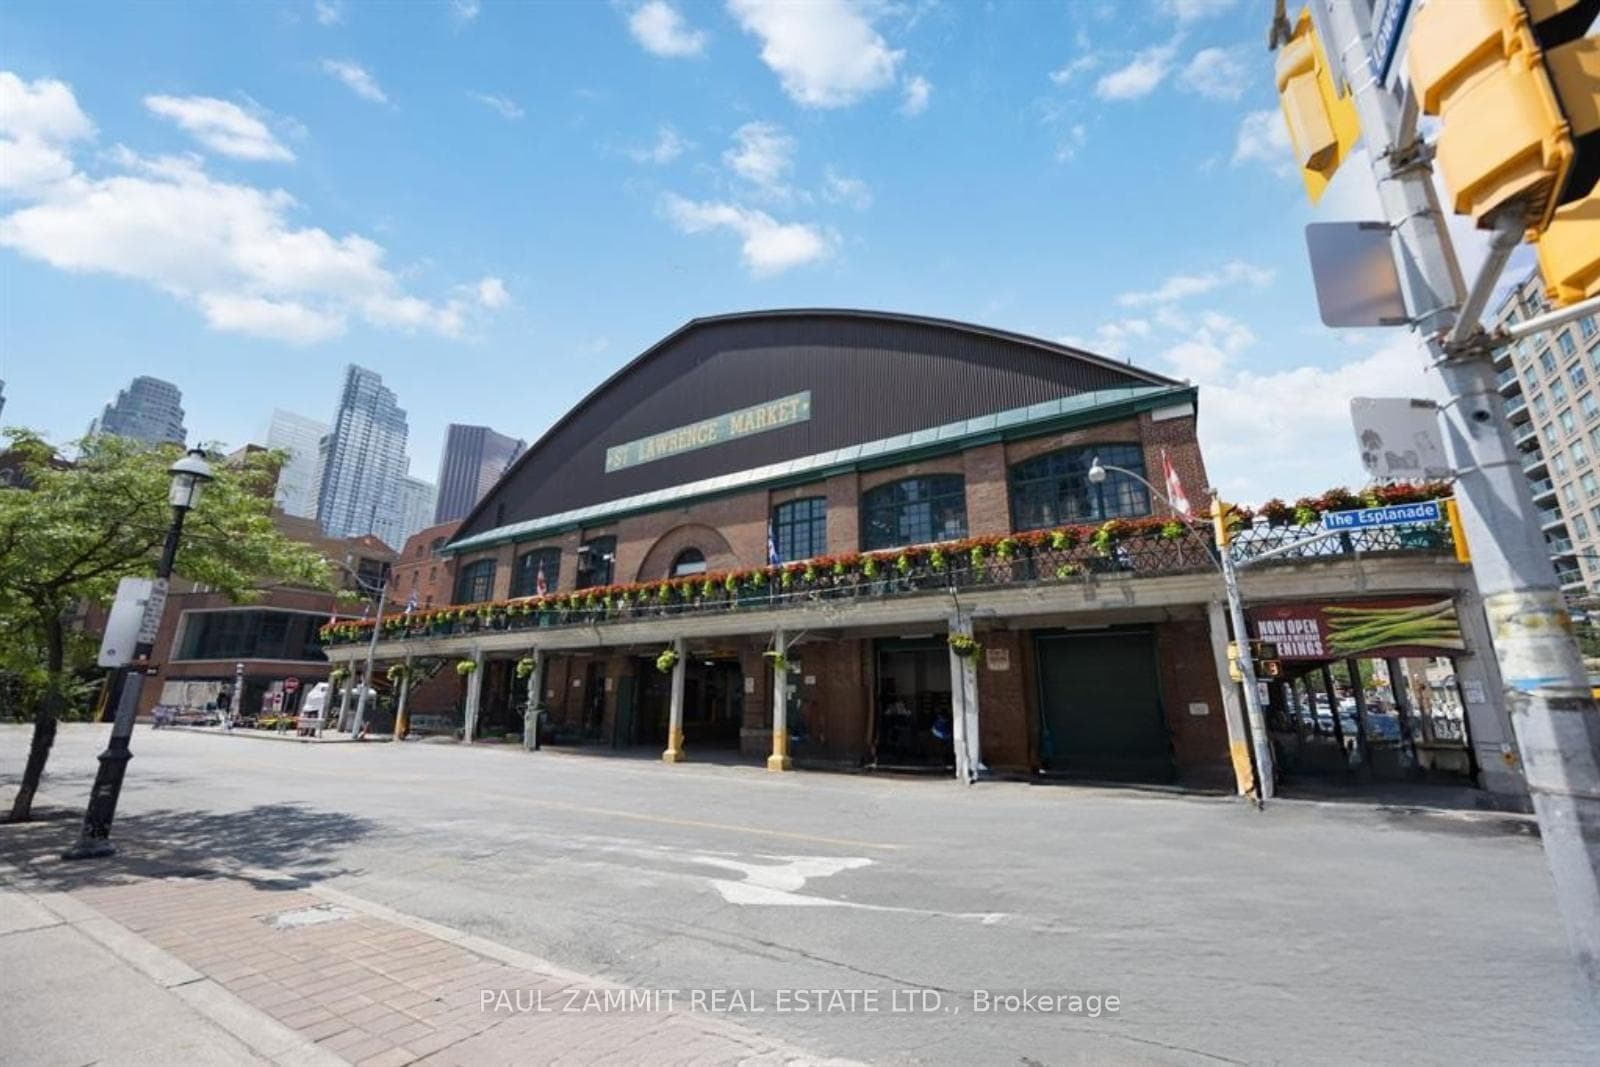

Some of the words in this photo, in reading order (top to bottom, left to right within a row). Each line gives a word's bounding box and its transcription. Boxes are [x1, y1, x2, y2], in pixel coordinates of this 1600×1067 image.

[638, 422, 719, 463] LAWRENCE
[730, 399, 801, 435] MARKET
[1326, 513, 1354, 527] The
[1358, 504, 1435, 525] Esplanade
[1258, 620, 1286, 635] NOW
[1286, 619, 1319, 634] OPEN
[1276, 640, 1323, 656] ENINGS
